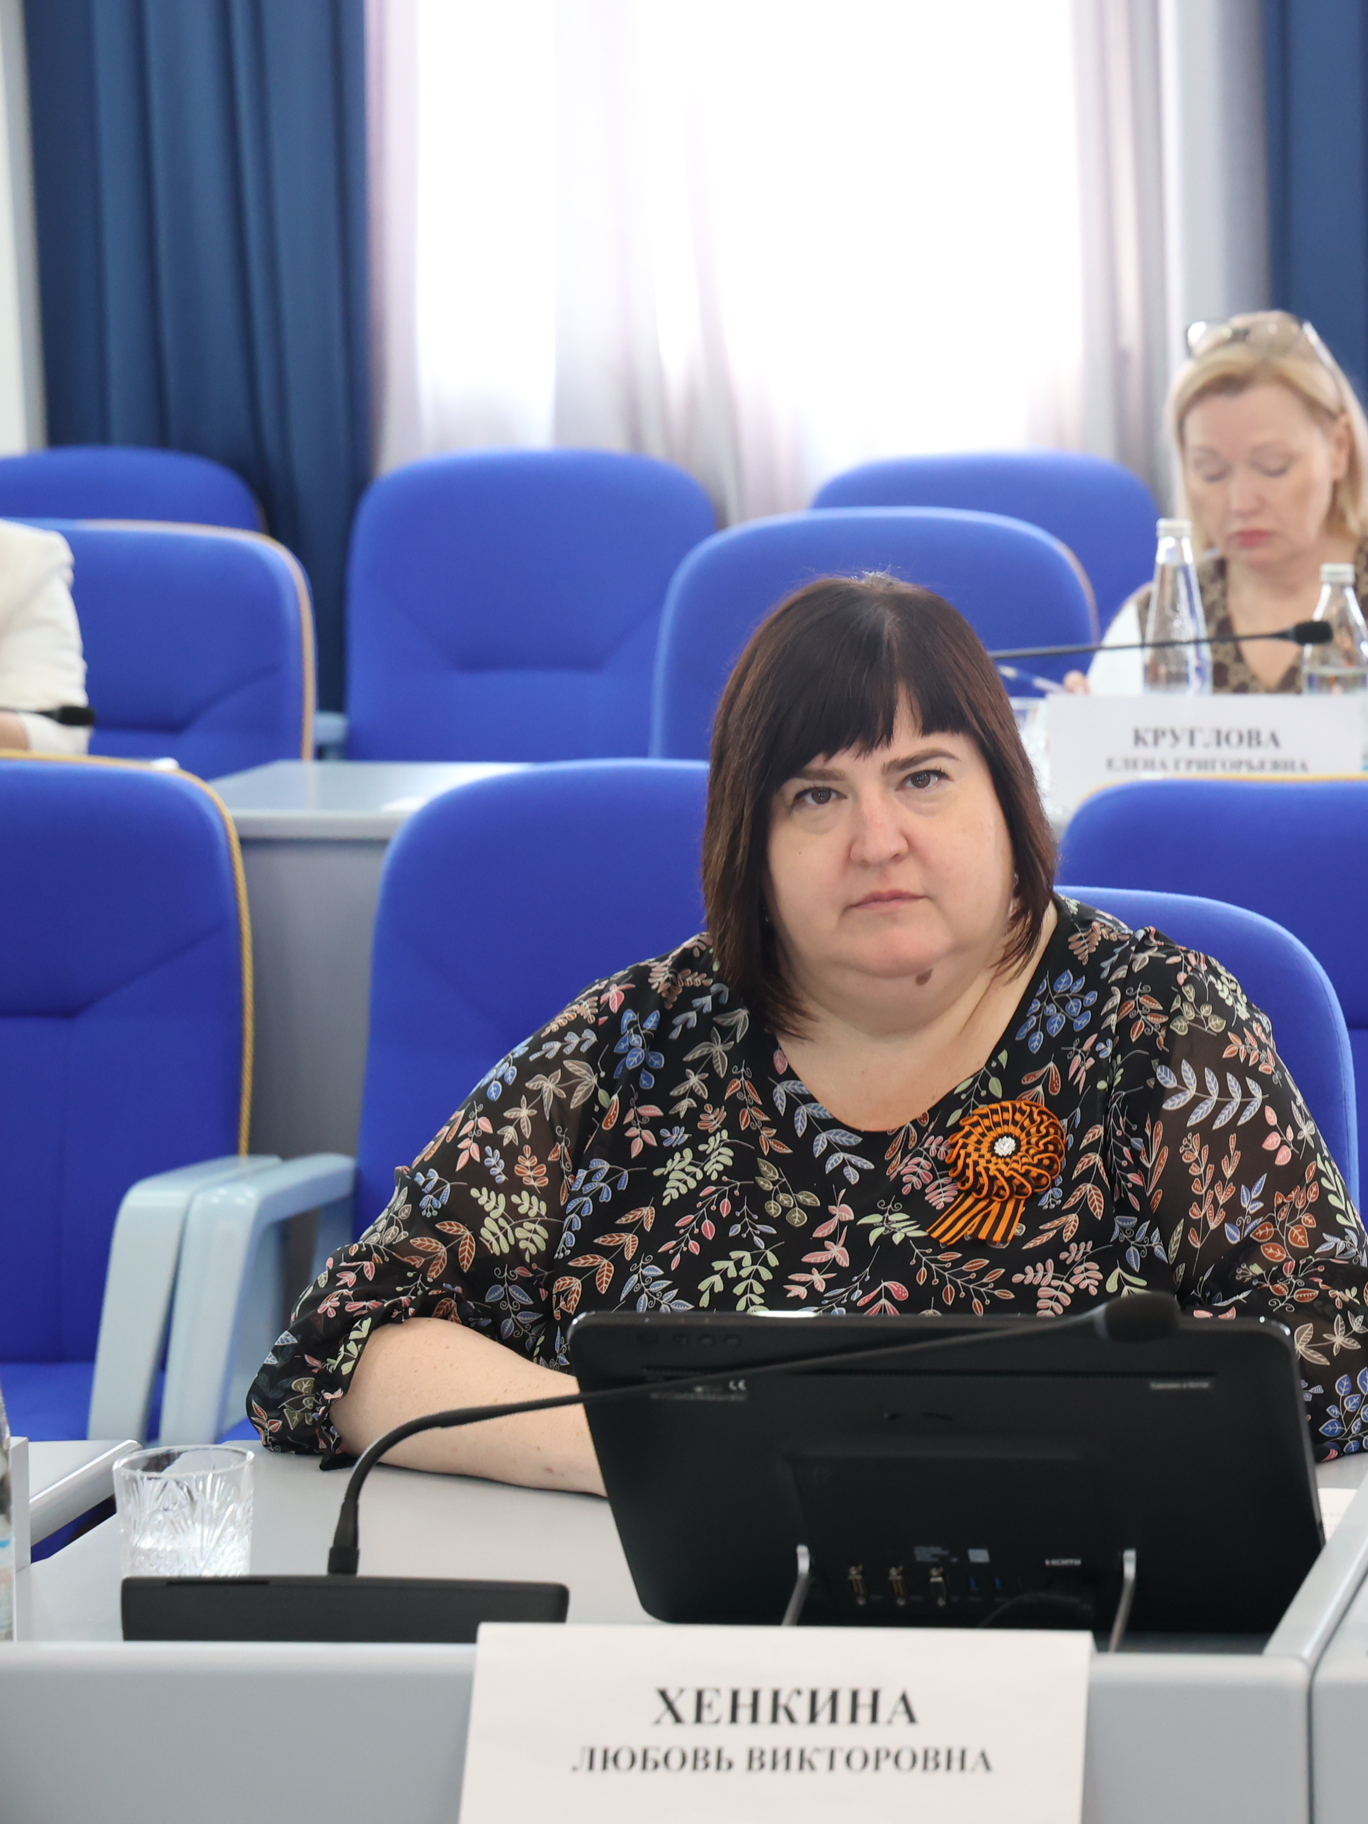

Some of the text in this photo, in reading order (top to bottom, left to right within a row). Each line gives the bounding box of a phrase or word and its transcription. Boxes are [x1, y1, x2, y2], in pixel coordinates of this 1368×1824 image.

[1131, 727, 1282, 749] КРУГЛОВА
[1105, 757, 1310, 774] ЕЛЕНА ГРИГОРЬЕВНА
[652, 1687, 920, 1727] ХЕНКИНА
[571, 1746, 994, 1774] ЛЮБОВЬ ВИКТОРОВНА
